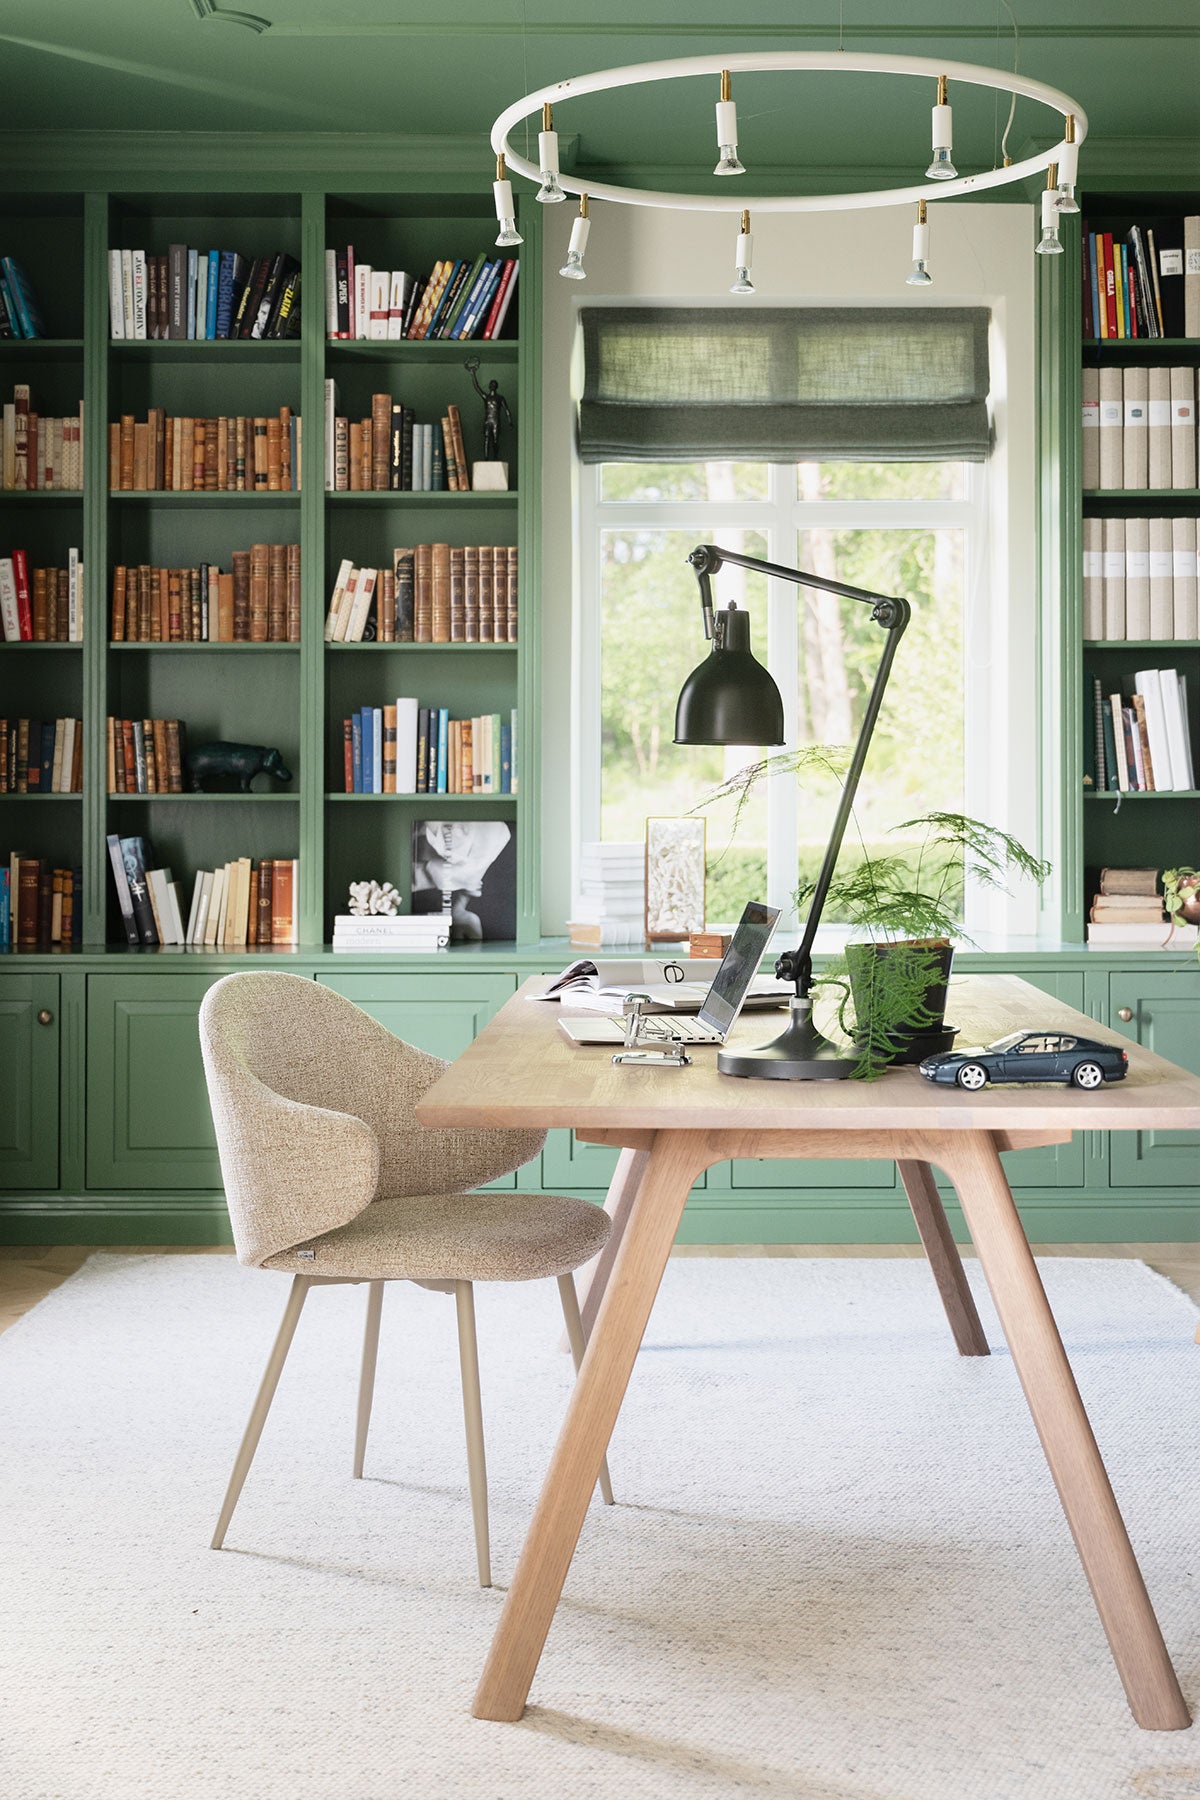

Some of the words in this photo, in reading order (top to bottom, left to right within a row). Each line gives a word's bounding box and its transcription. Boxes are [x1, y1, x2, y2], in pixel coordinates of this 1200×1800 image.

[135, 275, 143, 304] ELTON
[217, 251, 235, 336] PERSBRANDT
[280, 288, 293, 319] ZLATAN
[339, 280, 348, 304] SAPIENS
